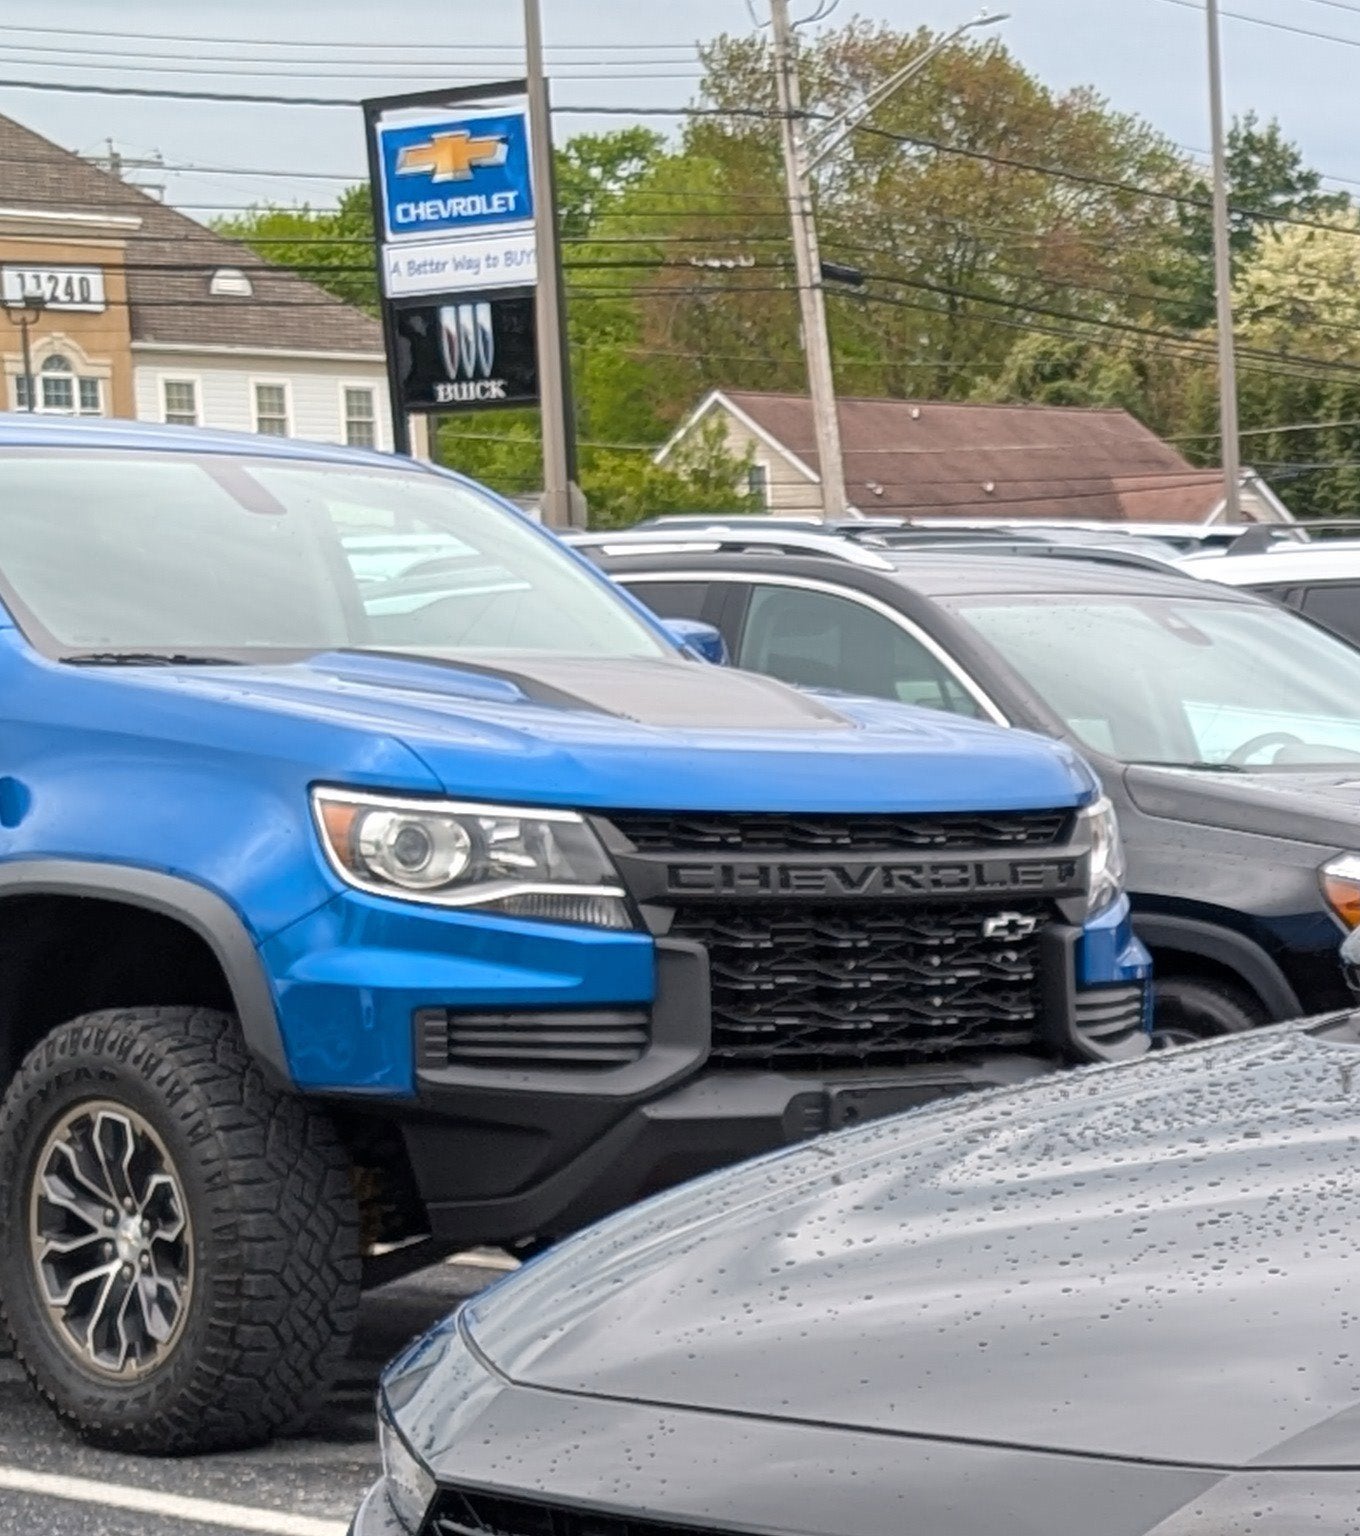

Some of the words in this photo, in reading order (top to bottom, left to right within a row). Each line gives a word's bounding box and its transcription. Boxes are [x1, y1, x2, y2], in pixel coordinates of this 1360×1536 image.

[396, 191, 519, 224] CHEVROLET
[391, 261, 402, 277] A
[407, 258, 448, 277] Better
[452, 255, 481, 275] Way
[485, 252, 499, 269] to
[433, 379, 508, 402] BUICK
[667, 862, 1075, 893] CHEVROLET
